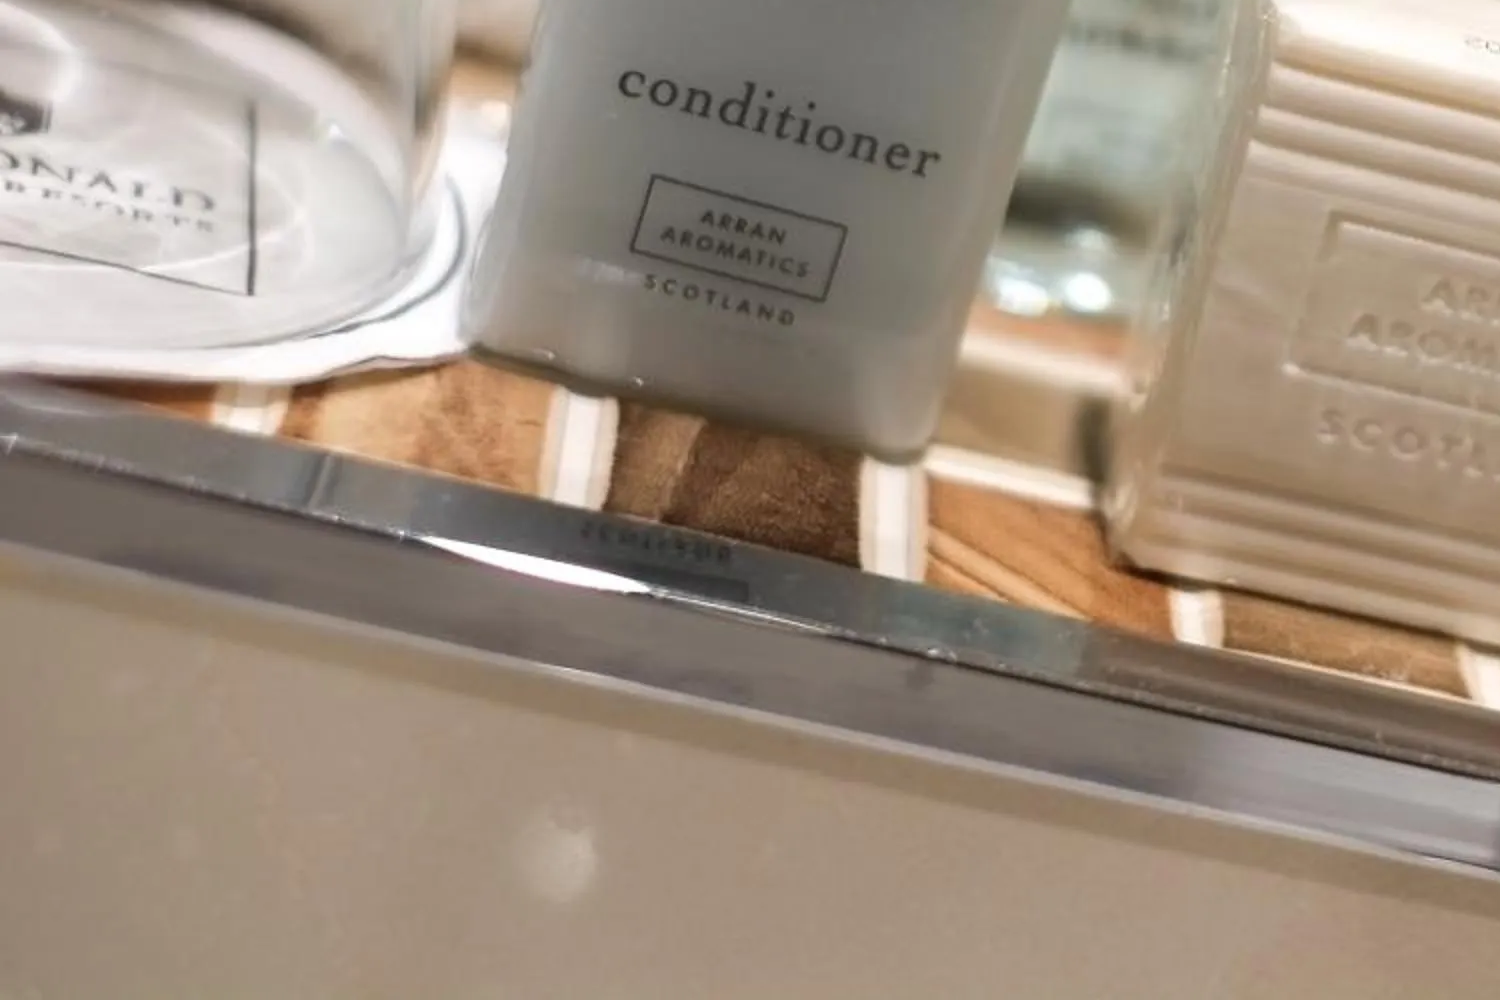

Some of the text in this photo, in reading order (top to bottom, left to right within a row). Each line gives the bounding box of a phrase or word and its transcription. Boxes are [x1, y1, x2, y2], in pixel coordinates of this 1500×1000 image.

[617, 69, 942, 179] conditioner
[660, 225, 812, 280] AROMATICS
[700, 209, 788, 246] ARRAN
[643, 273, 797, 327] SCOTLAND
